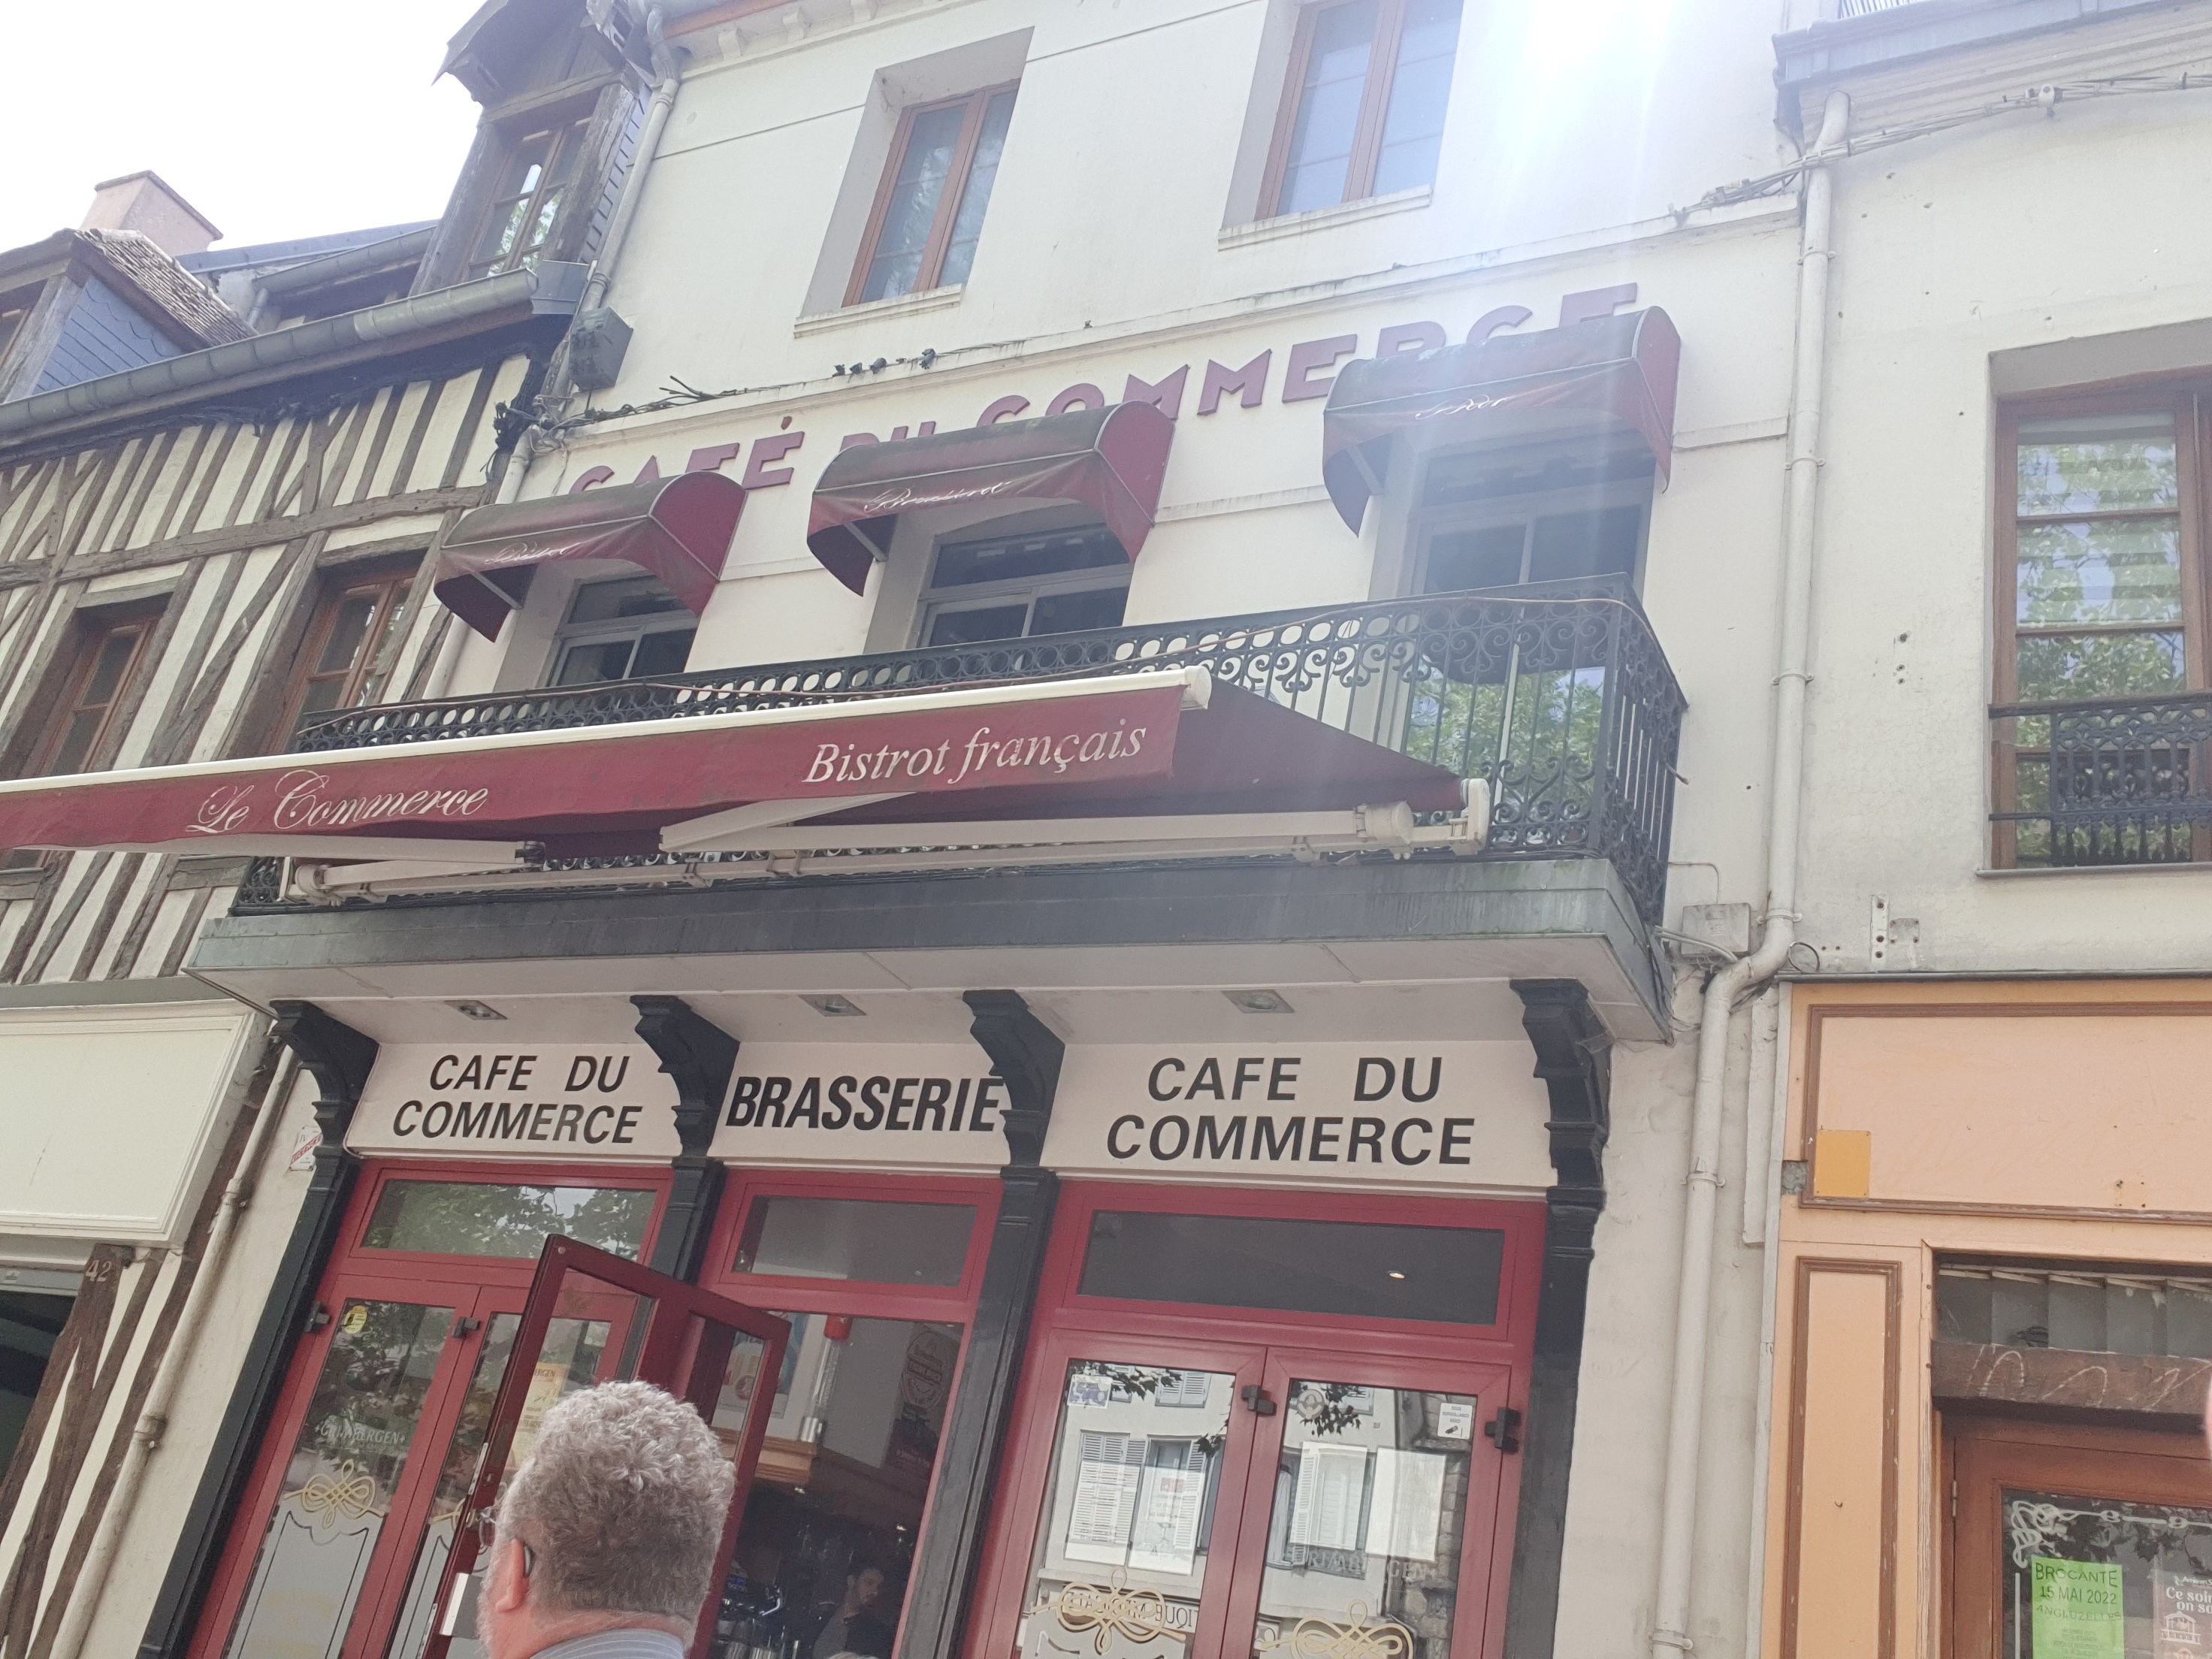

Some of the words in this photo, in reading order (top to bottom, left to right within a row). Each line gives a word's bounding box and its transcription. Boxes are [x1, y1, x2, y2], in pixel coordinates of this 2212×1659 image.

[802, 739, 950, 783] Bistrot
[948, 718, 1147, 784] français
[186, 784, 255, 833] Le
[273, 769, 490, 830] Commerce
[429, 1054, 538, 1091] CAFE
[564, 1056, 630, 1092] DU
[1148, 1057, 1301, 1101] CAFE
[1354, 1056, 1443, 1103] DU
[393, 1100, 643, 1144] COMMERCE
[726, 1075, 1004, 1132] BRASSERIE
[1107, 1114, 1476, 1166] COMMERCE
[86, 1259, 112, 1283] 42
[2035, 1562, 2118, 1588] BROCANTE
[2039, 1585, 2054, 1599] 15
[2059, 1586, 2082, 1603] MAI
[2086, 1589, 2117, 1605] 2022
[2165, 1586, 2183, 1600] Ce
[2176, 1601, 2194, 1612] on
